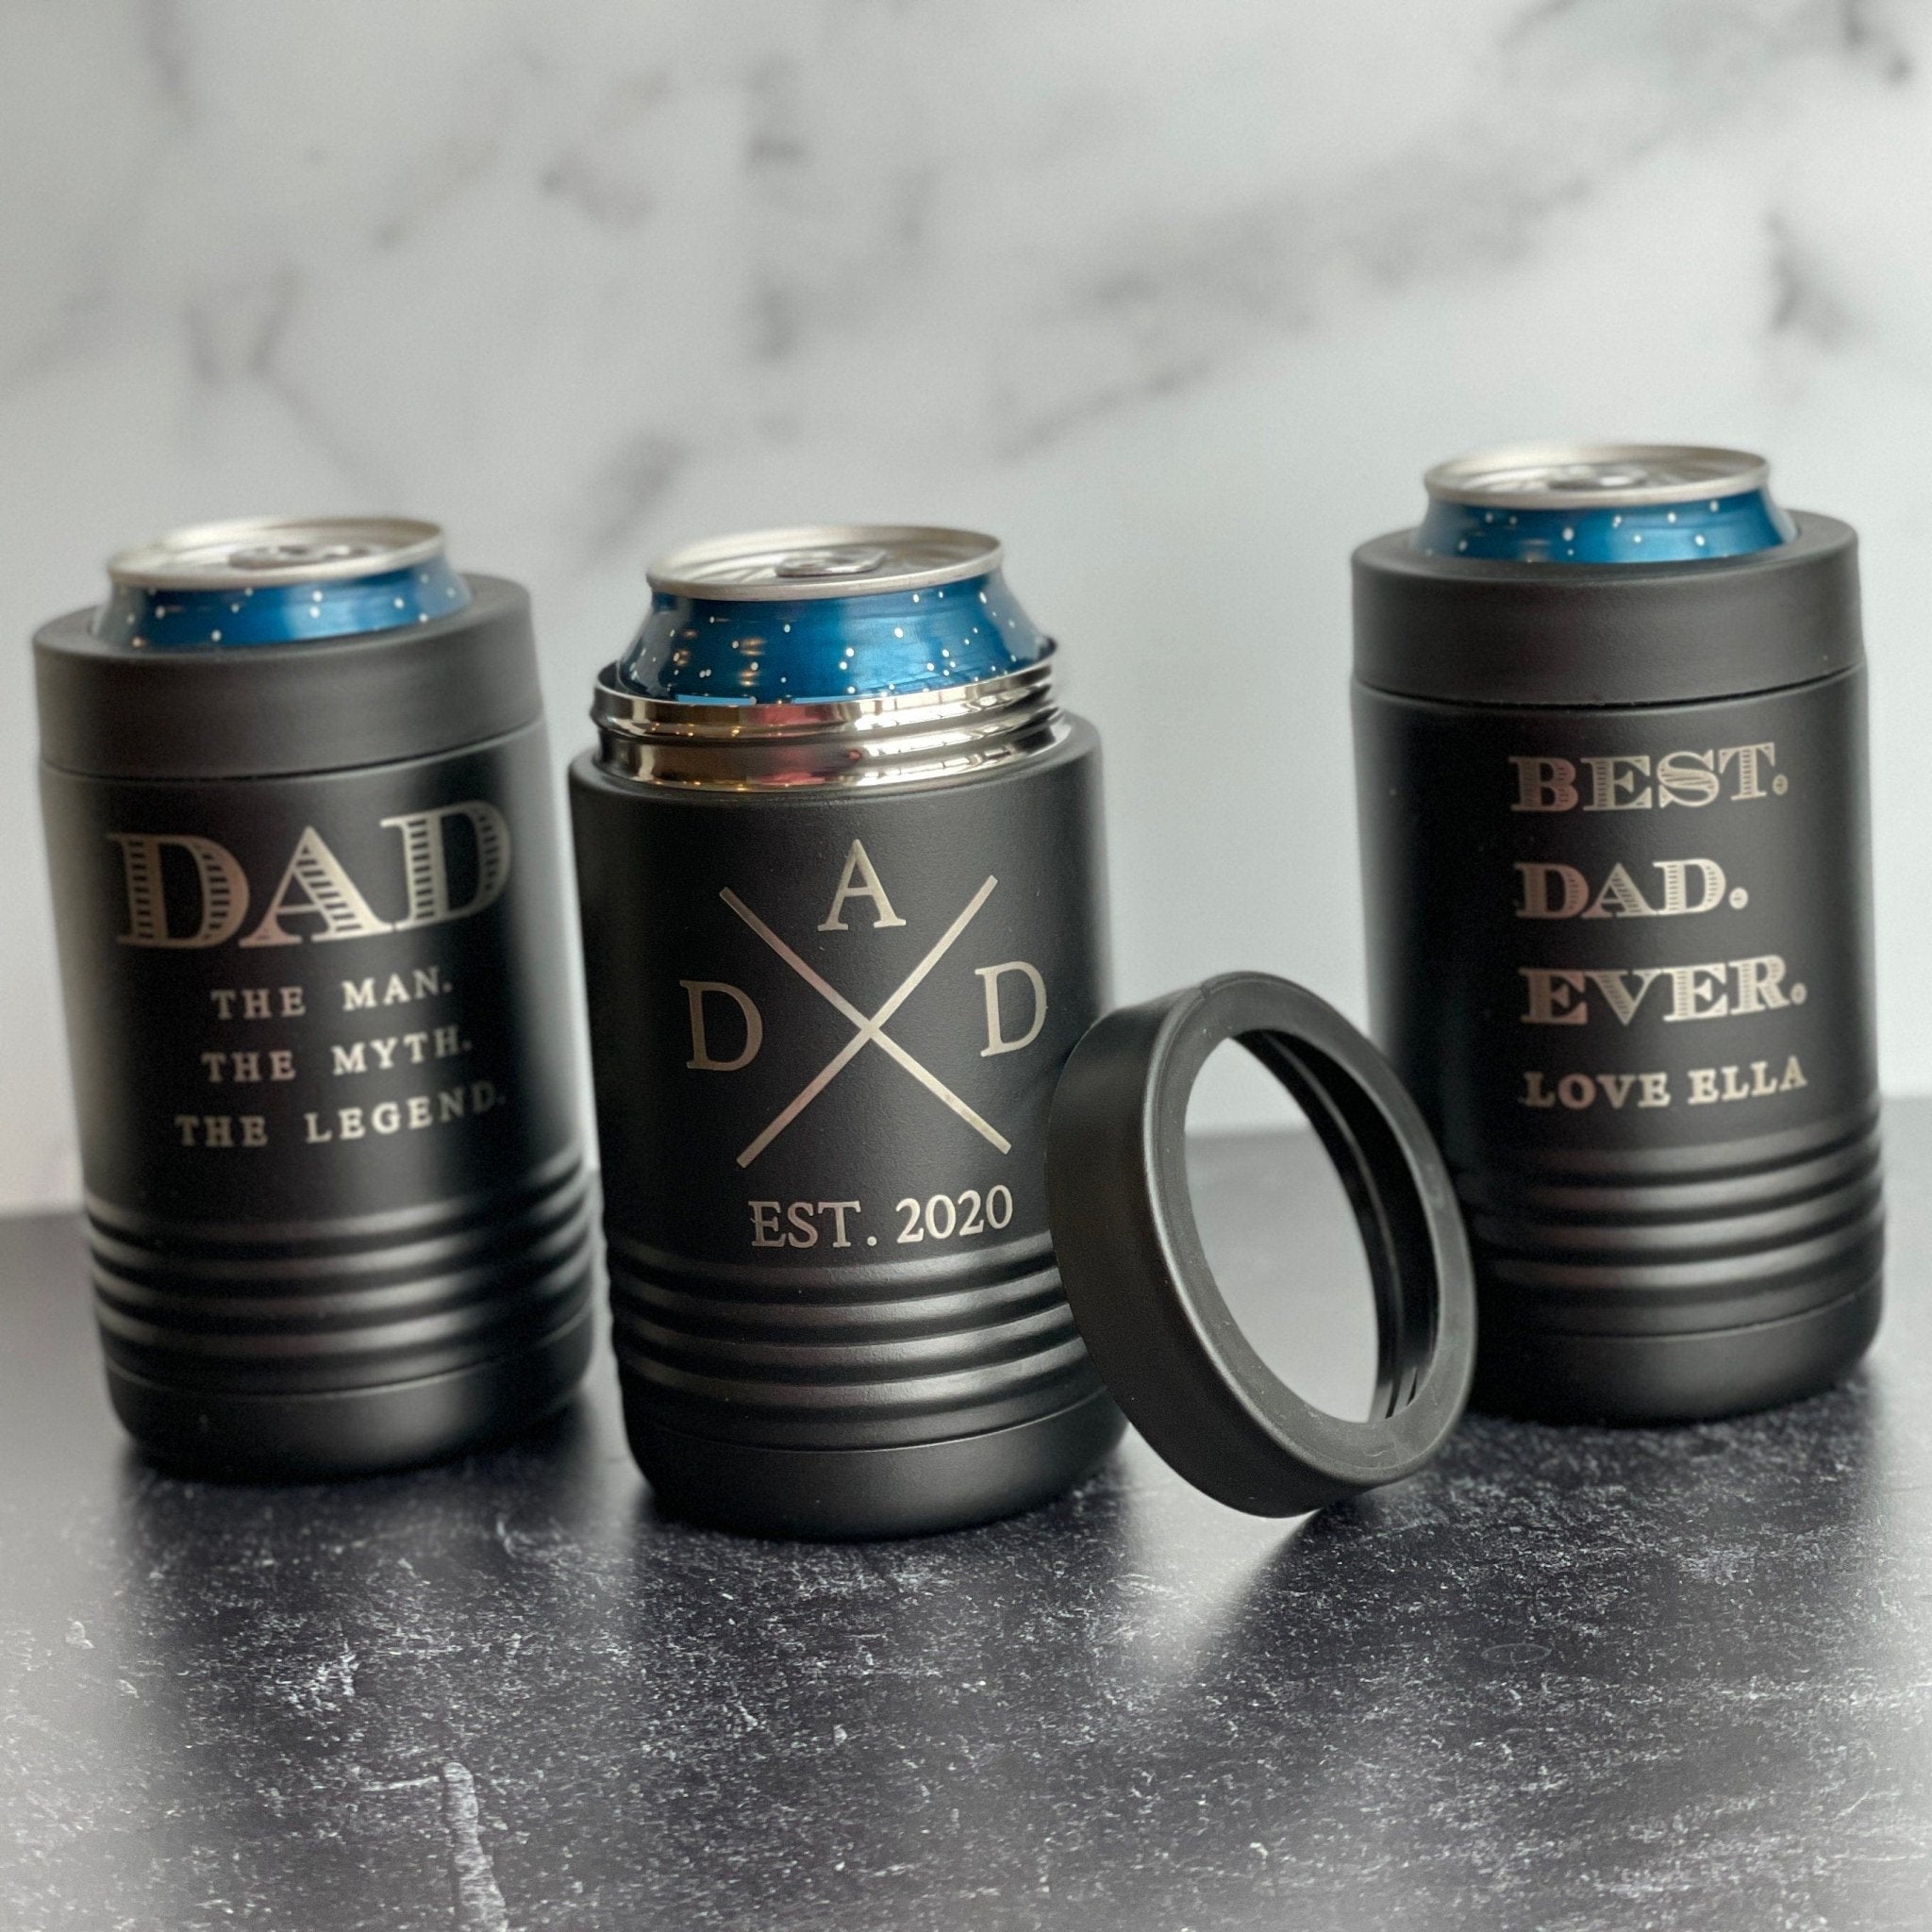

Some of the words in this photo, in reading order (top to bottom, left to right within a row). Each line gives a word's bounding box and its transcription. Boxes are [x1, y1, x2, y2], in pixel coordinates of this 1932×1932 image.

[1508, 741, 1789, 812] BEST.
[107, 800, 512, 949] DAD
[817, 839, 907, 932] A
[1514, 858, 1749, 919] DAD.
[211, 986, 306, 1020] THE
[341, 965, 453, 1011] MAN.
[974, 960, 1048, 1057] D
[1519, 954, 1807, 1026] EVER.
[201, 1049, 296, 1082] THE
[331, 1024, 471, 1076] MYTH.
[679, 979, 763, 1072] D
[175, 1114, 268, 1148] THE
[304, 1080, 507, 1143] LEGEND.
[1522, 1072, 1671, 1109] LOVE
[1688, 1055, 1807, 1106] ELLA
[748, 1199, 877, 1249] EST.
[895, 1184, 1014, 1244] 2020
